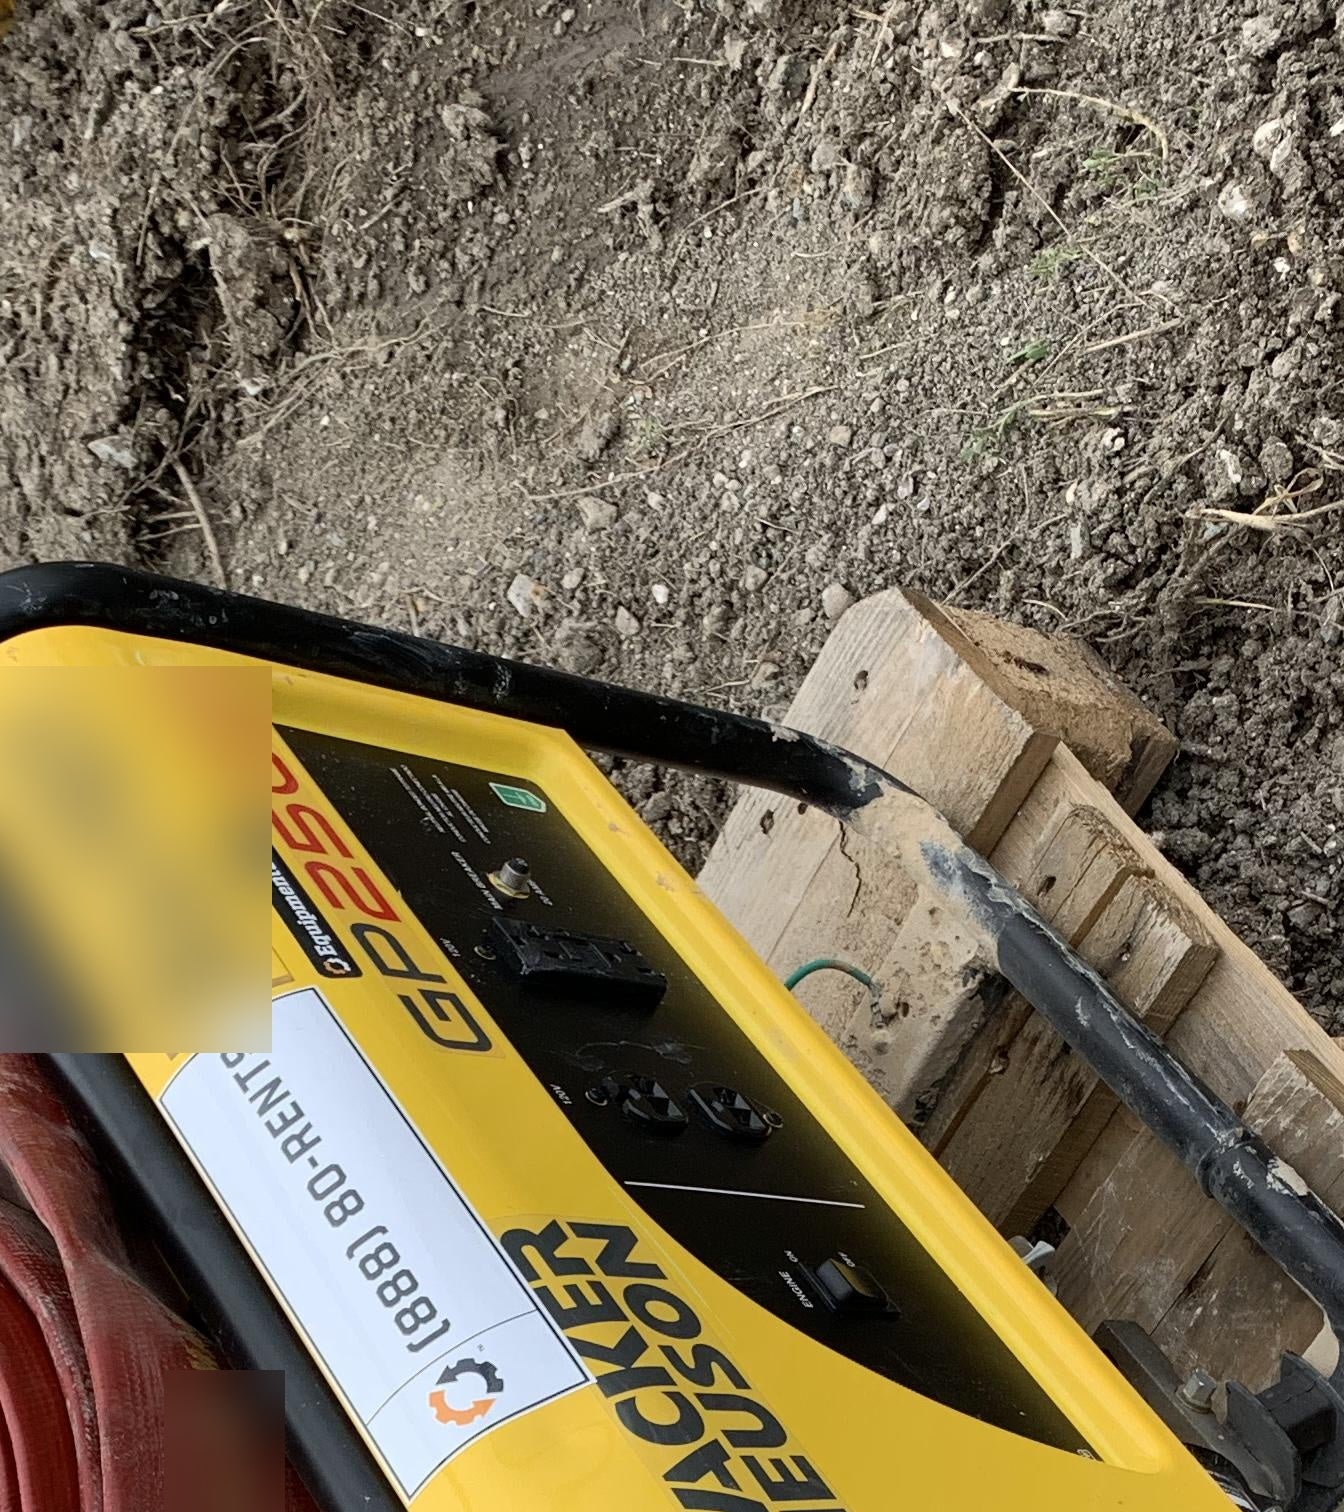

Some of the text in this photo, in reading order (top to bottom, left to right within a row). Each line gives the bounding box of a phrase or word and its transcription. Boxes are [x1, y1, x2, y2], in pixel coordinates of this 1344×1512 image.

[272, 862, 337, 956] Equipment
[440, 937, 462, 958] 120V
[550, 1083, 572, 1105] 120V
[784, 1249, 799, 1263] ON
[838, 1250, 856, 1268] OFF
[345, 1225, 452, 1353] (888)
[779, 1270, 814, 1309] ENGINE
